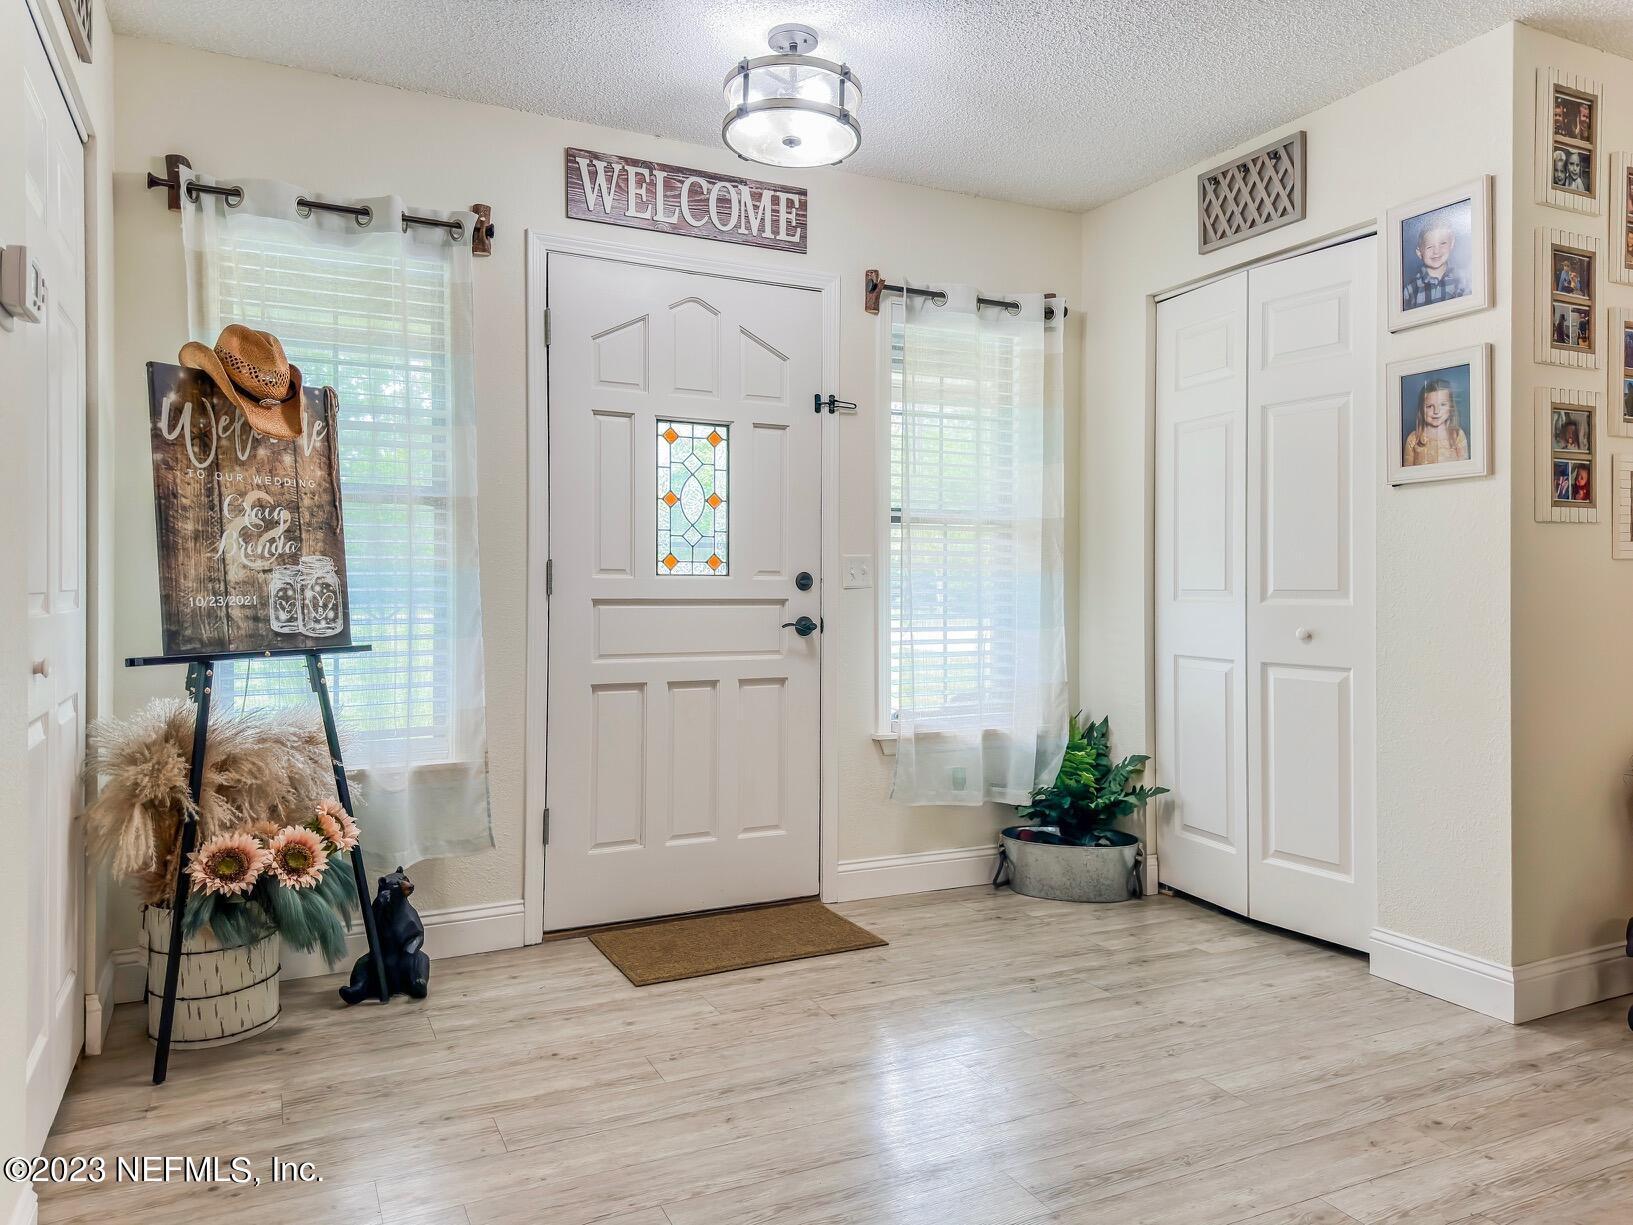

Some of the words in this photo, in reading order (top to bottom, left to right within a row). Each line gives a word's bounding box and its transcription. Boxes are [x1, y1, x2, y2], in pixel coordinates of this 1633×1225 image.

[575, 157, 800, 242] WELCOME
[161, 397, 328, 469] Wele
[187, 469, 205, 479] TO
[215, 471, 243, 481] OUR
[253, 475, 316, 488] WEDDING
[223, 494, 284, 533] Craig
[189, 595, 258, 607] 10/23/2021
